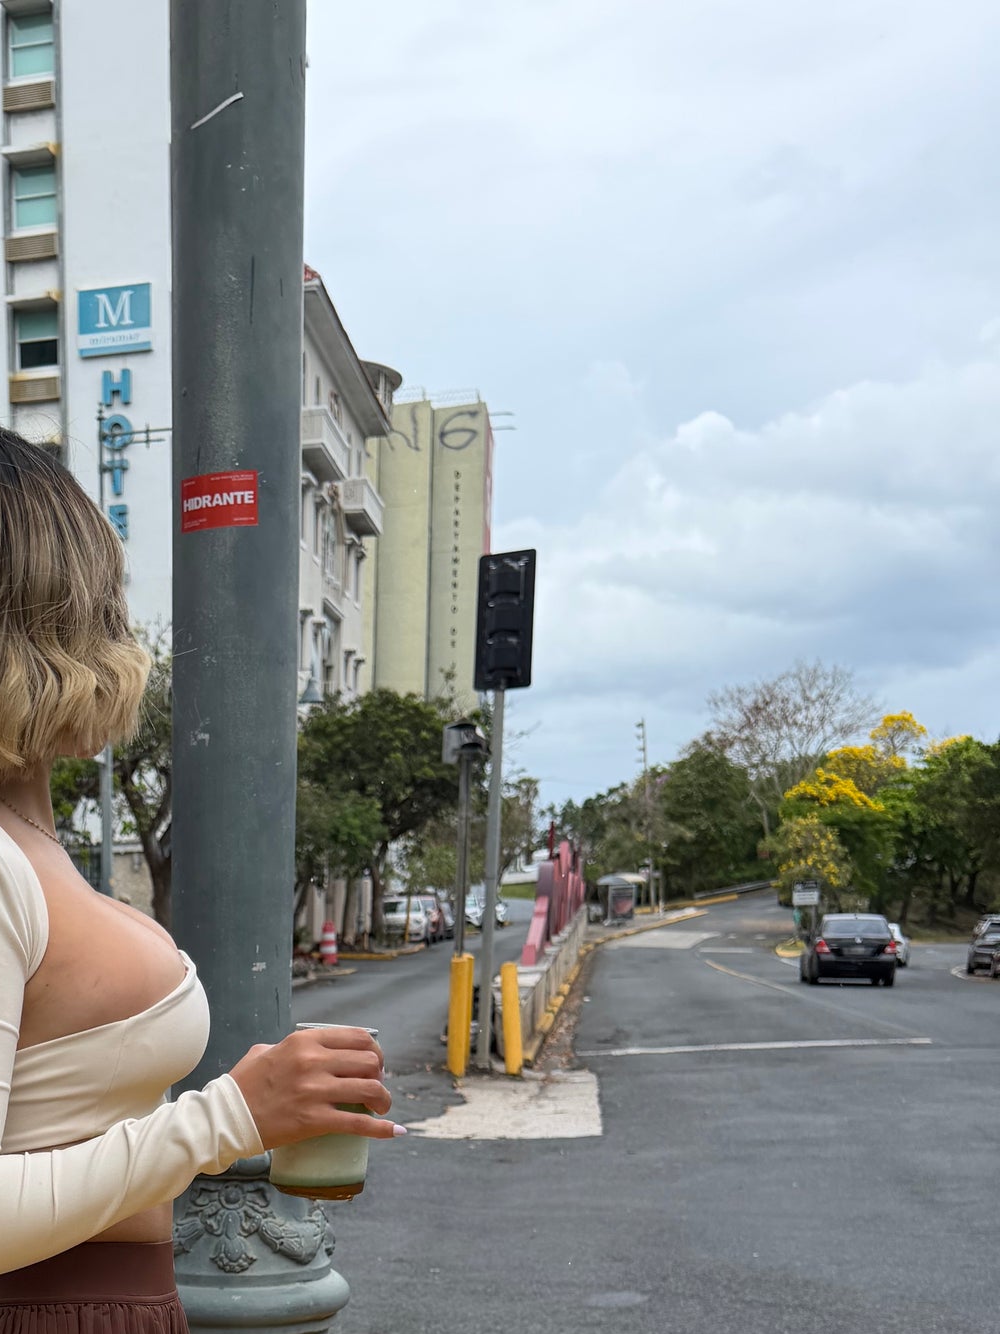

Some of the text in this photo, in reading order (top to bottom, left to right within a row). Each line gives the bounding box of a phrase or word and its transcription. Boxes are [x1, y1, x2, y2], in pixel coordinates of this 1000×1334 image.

[94, 289, 135, 329] M
[101, 367, 133, 588] HOTE
[183, 490, 254, 513] HIDRANTE
